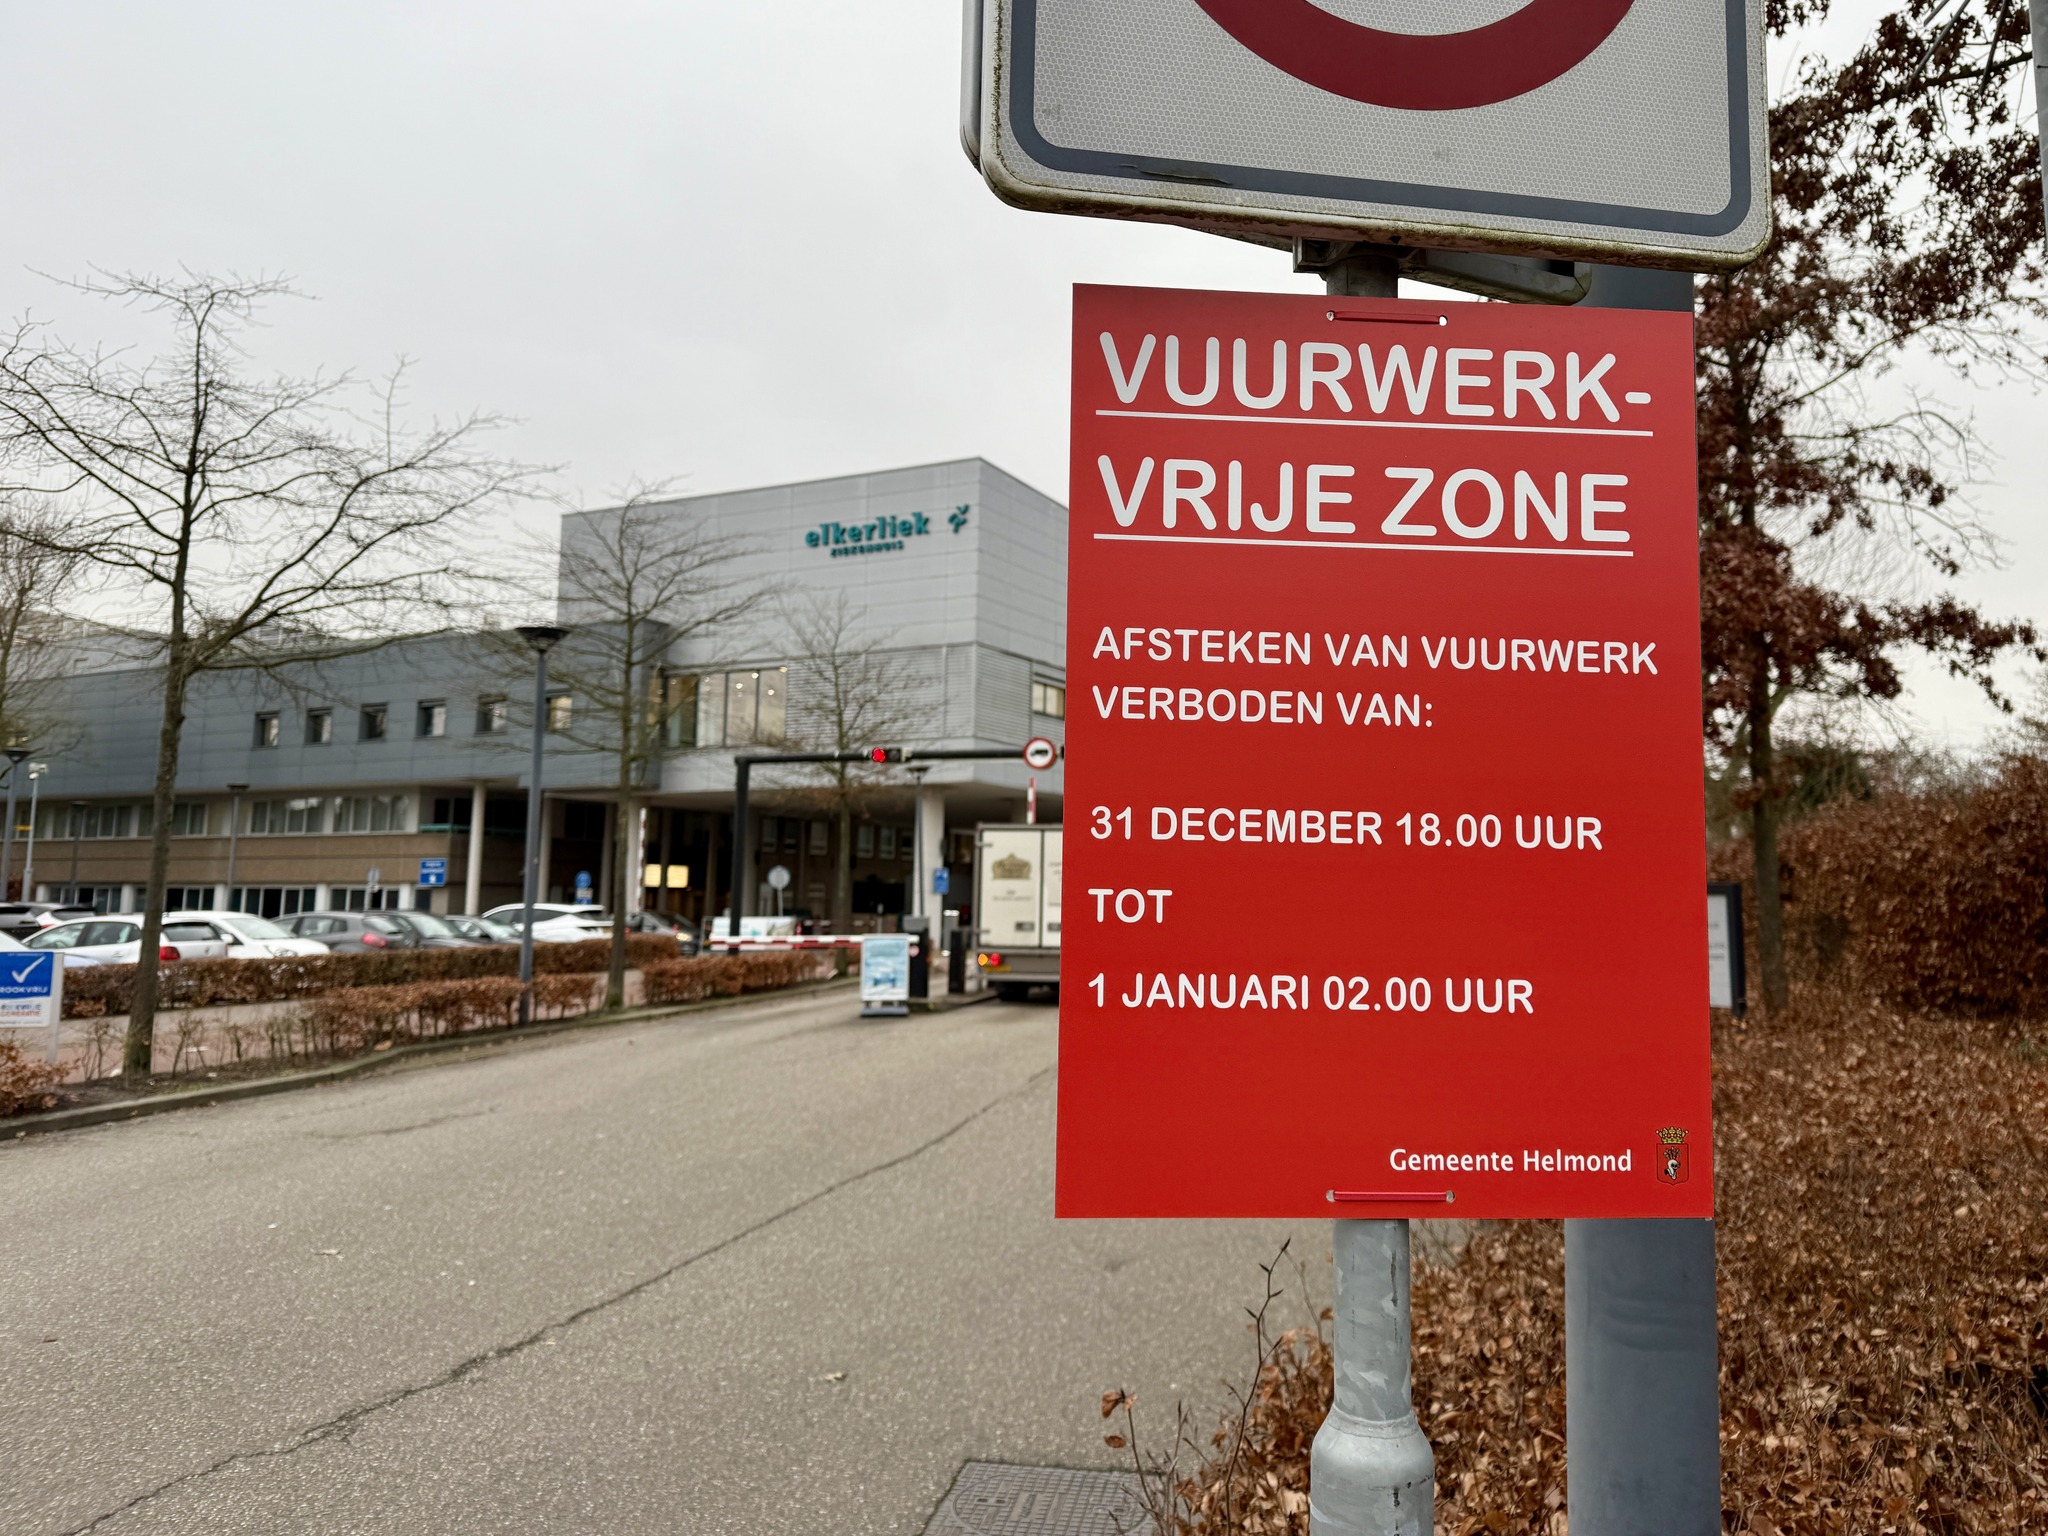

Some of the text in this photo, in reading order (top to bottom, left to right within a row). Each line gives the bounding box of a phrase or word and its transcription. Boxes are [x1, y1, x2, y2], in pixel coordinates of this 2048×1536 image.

[1099, 331, 1652, 423] VUURWERK-
[1097, 454, 1631, 543] VRIJE ZONE
[805, 511, 930, 548] elkerliek
[1092, 626, 1658, 675] AFSTEKEN VAN VUURWERK
[1092, 685, 1433, 728] VERBODEN VAN:
[1090, 805, 1603, 851] 31 DECEMBER 18.00 UUR
[1087, 888, 1173, 924] TOT
[1088, 972, 1534, 1014] 1 JANUARI 02.00 UUR
[1389, 1148, 1632, 1172] Gemeente Helmond
